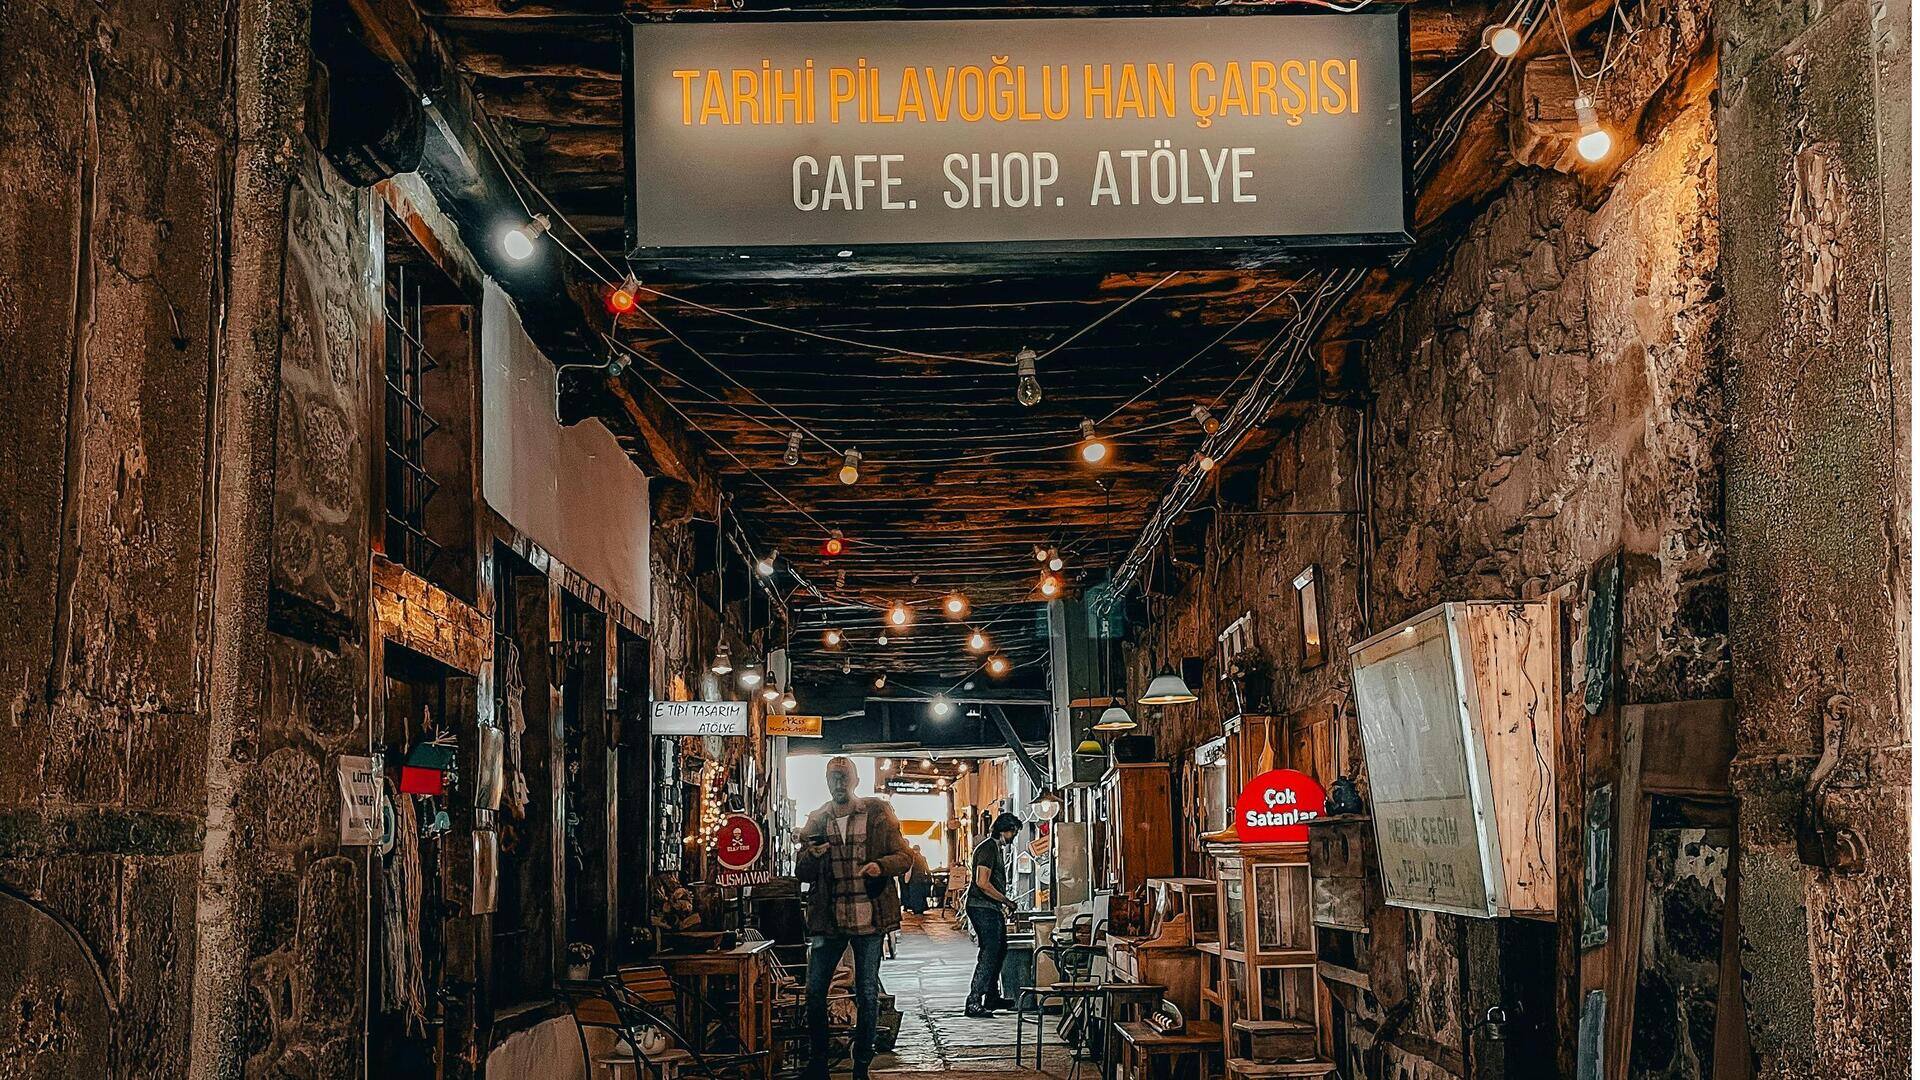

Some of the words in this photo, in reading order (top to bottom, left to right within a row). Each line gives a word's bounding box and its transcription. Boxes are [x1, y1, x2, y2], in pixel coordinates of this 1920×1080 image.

[672, 58, 816, 125] TARİHİ
[829, 55, 1071, 125] PİLAVOĞLU
[1083, 62, 1177, 120] HAN
[1189, 58, 1359, 128] ÇARŞISI
[791, 154, 917, 211] CAFE.
[942, 151, 1065, 209] SHOP.
[1090, 139, 1257, 206] ATÖLYE
[654, 703, 665, 717] E
[691, 704, 740, 717] TASARIM
[352, 769, 371, 783] LÜTF
[1263, 787, 1297, 809] Çok
[1245, 808, 1318, 827] Satanlar
